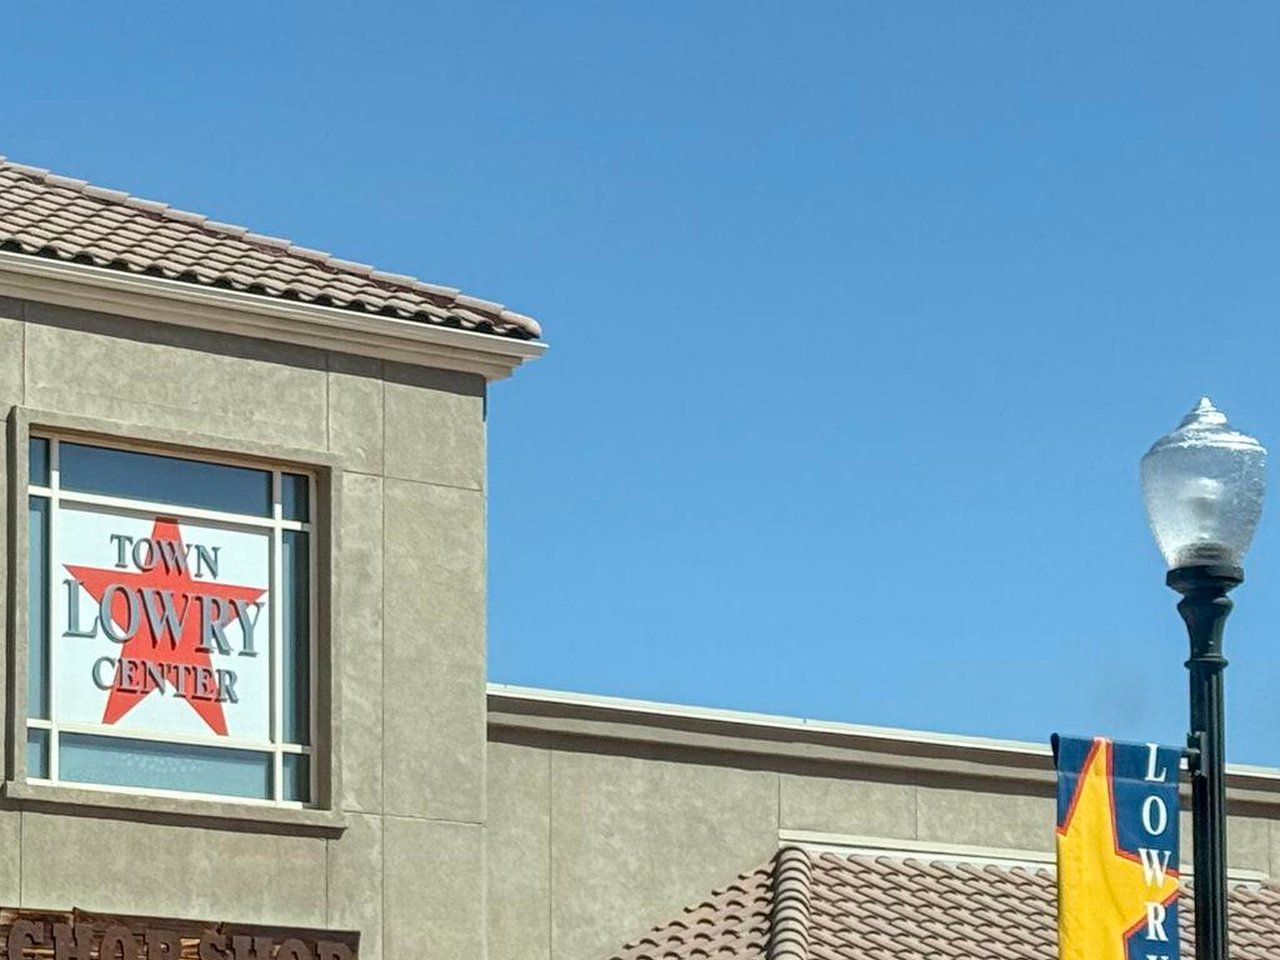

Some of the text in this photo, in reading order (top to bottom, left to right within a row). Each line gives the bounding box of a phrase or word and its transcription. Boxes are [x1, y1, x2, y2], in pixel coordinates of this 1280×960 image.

[110, 533, 221, 580] TOWN
[62, 579, 266, 658] LOWRY
[92, 656, 239, 704] CENTER
